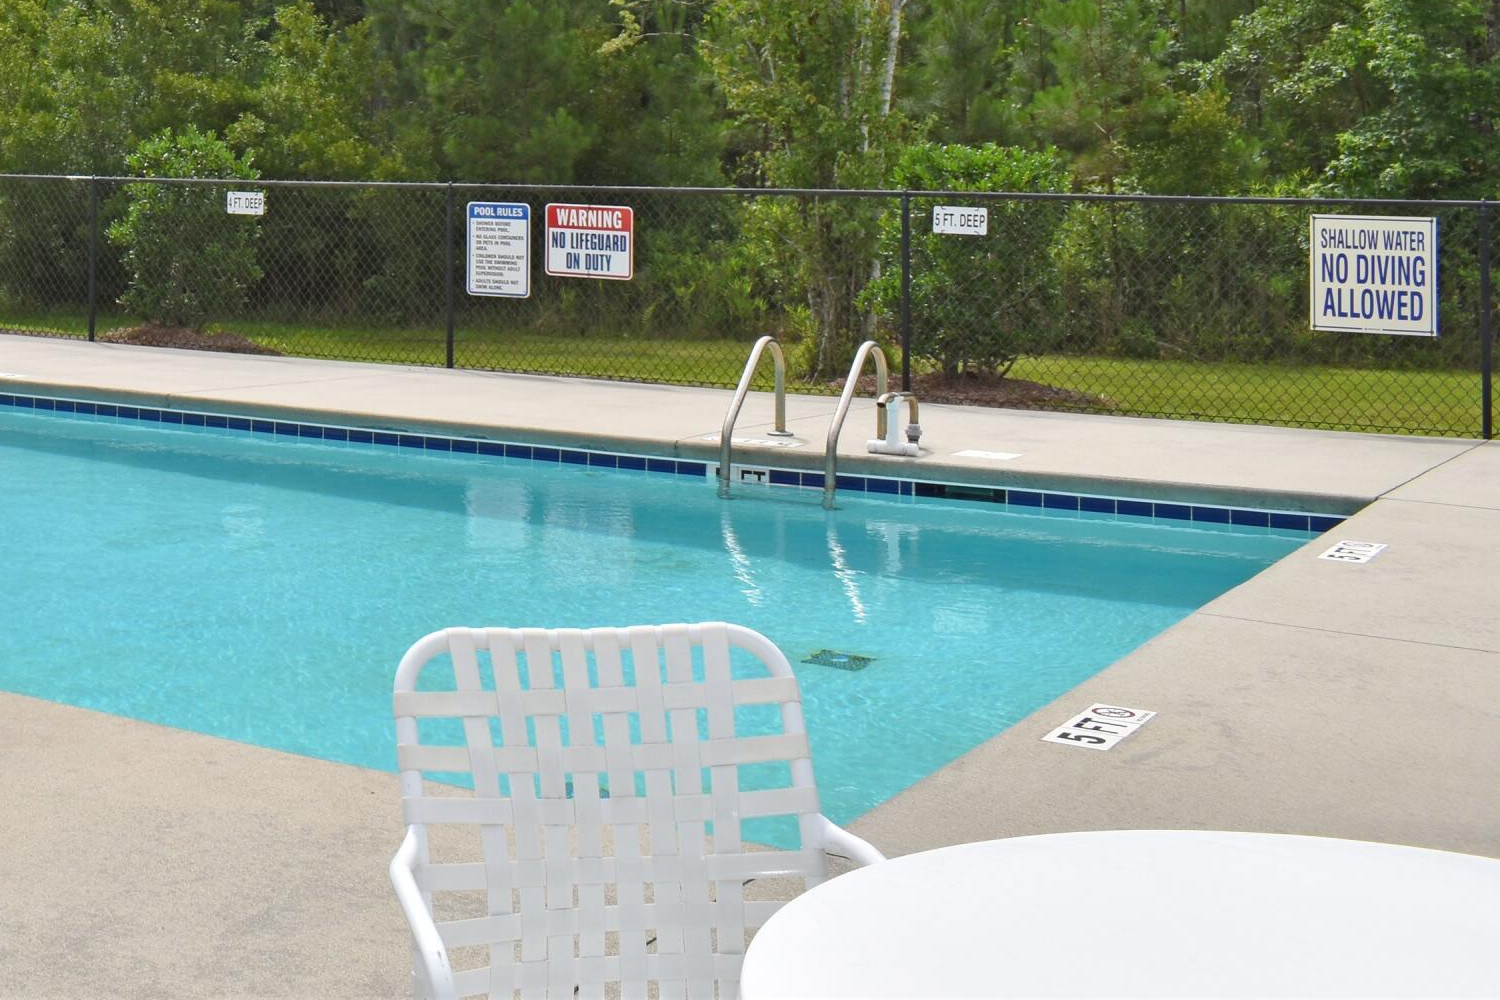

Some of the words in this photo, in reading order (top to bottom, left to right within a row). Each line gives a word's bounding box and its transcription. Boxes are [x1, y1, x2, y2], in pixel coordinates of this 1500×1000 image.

[245, 197, 262, 209] DEEP
[474, 207, 495, 216] POOL
[497, 207, 523, 217] RULES
[556, 208, 622, 229] WARNING
[935, 213, 940, 226] 5
[943, 213, 957, 227] FT.
[960, 213, 986, 228] DEEP
[551, 231, 566, 249] NO
[570, 232, 627, 252] LIFEGUARD
[1320, 228, 1379, 250] SHALLOW
[1383, 230, 1425, 251] WATER
[566, 252, 580, 270] ON
[585, 253, 612, 272] DUTY
[1321, 253, 1349, 284] NO
[1356, 254, 1426, 287] DIVING
[1323, 287, 1424, 321] ALLOWED
[1072, 717, 1128, 735] FT
[1057, 732, 1106, 744] 5
